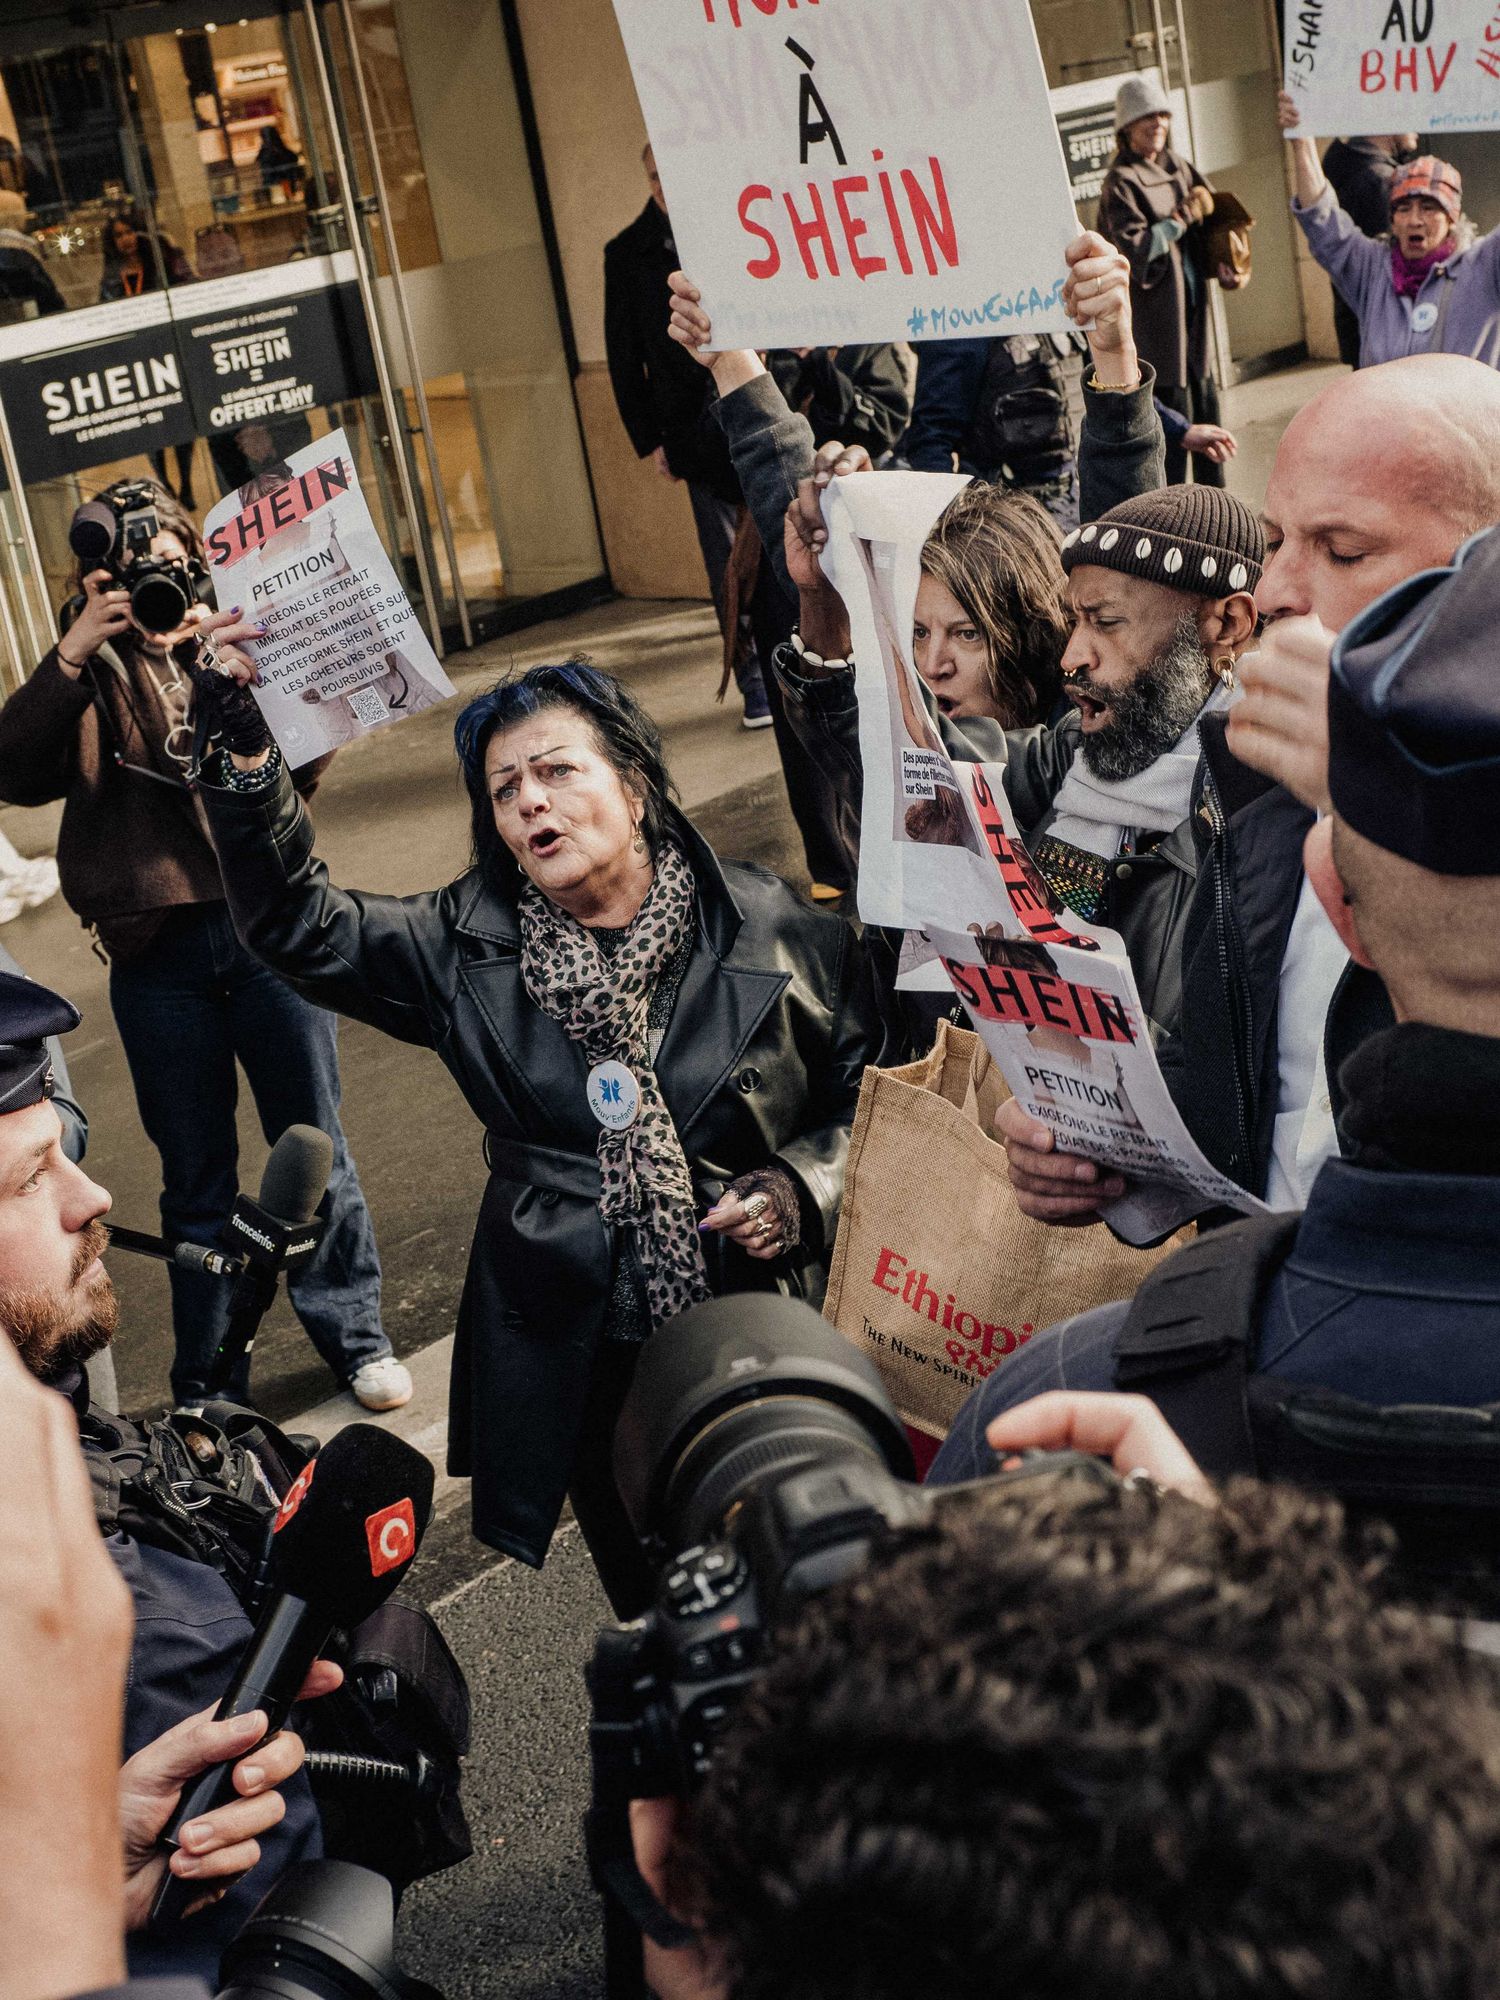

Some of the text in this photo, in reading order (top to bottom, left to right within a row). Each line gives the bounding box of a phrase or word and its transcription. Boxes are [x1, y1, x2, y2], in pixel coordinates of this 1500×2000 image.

[1381, 0, 1433, 43] AU
[1360, 42, 1457, 93] BHV
[784, 36, 847, 165] À
[213, 336, 292, 375] SHEIN
[41, 353, 181, 421] SHEIN
[208, 456, 350, 566] SHEIN
[252, 548, 335, 601] PETITION
[254, 568, 370, 628] XIGEONS LE RETRAIT
[255, 583, 382, 650] IMMÉDIAT DES POUPÉES
[255, 601, 385, 670] ÉDOPORNO-CRIMINELLES
[272, 643, 338, 680] PLATEFORME
[339, 627, 374, 648] SHEIN
[376, 619, 390, 632] ET
[281, 630, 406, 695] LES ACHETEURS SOIENT
[321, 661, 385, 695] POURSUIVIS
[903, 751, 914, 763] Des
[904, 766, 921, 779] forme
[922, 767, 930, 780] de
[905, 784, 915, 794] sur
[915, 782, 933, 796] Shein
[945, 957, 1137, 1048] SHEIN
[1024, 1065, 1124, 1113] PETITION
[1027, 1103, 1091, 1137] EXIGEONS
[231, 1213, 276, 1252] franceinfo:
[871, 1247, 1034, 1358] Ethiopi
[890, 1337, 929, 1365] NEW
[933, 1358, 982, 1388] SPIRI
